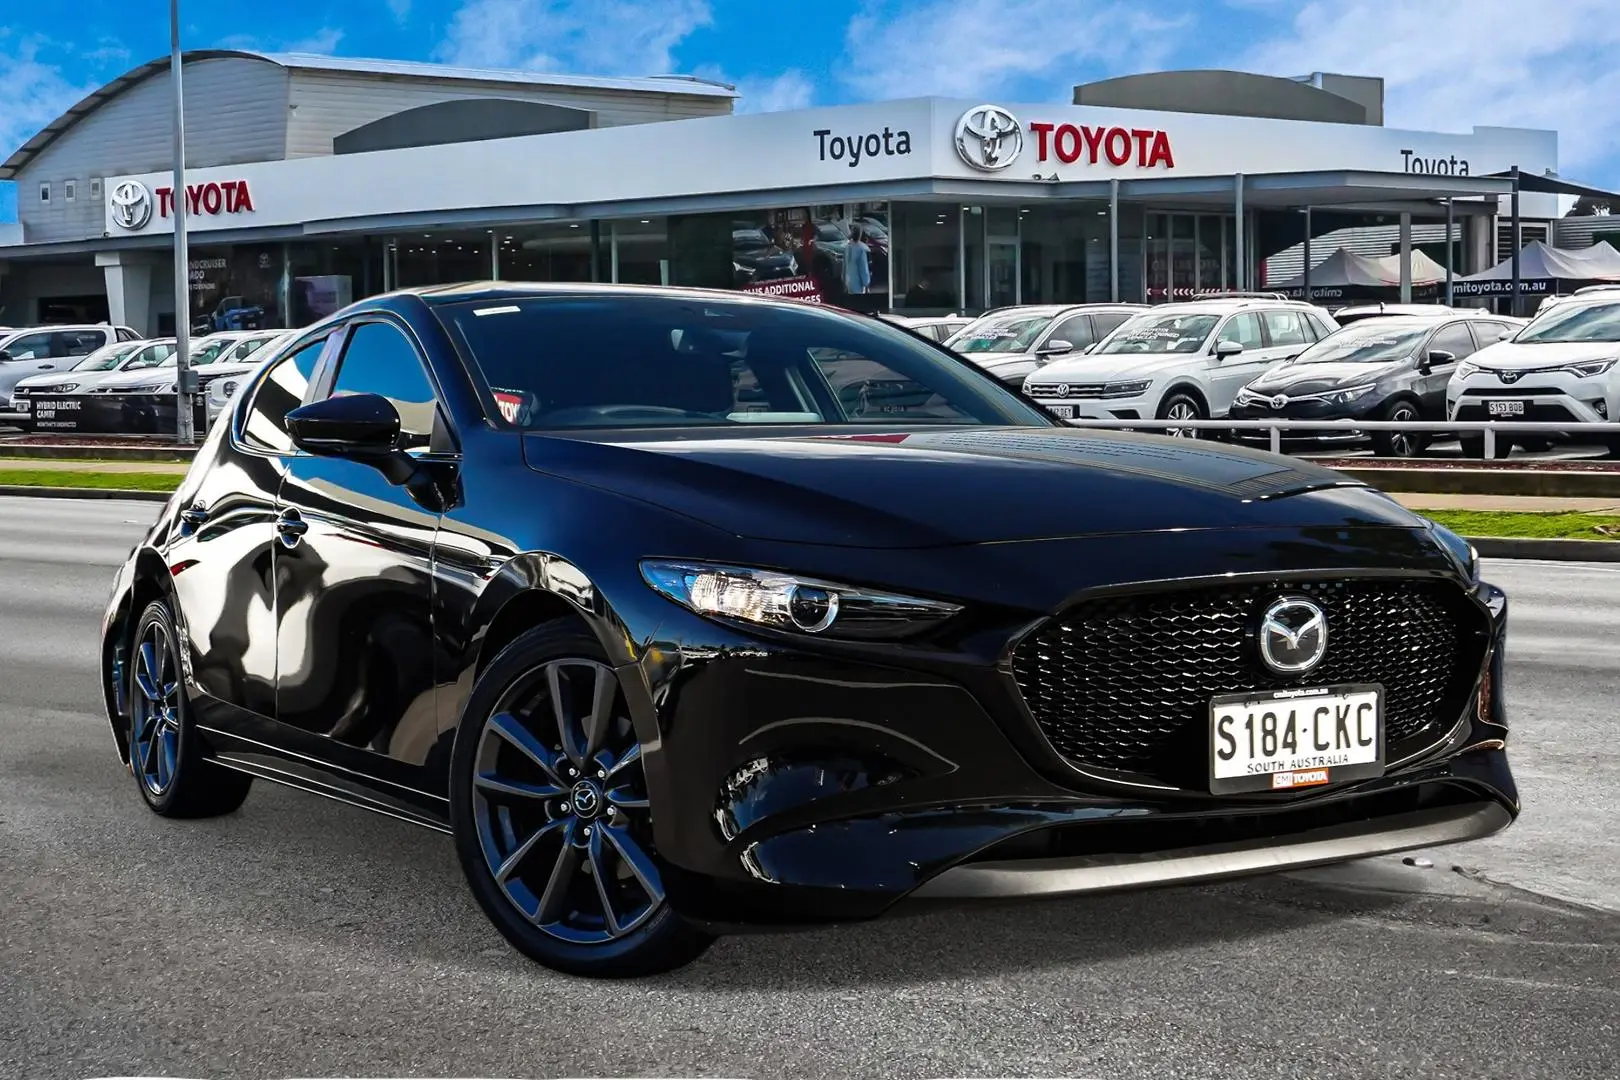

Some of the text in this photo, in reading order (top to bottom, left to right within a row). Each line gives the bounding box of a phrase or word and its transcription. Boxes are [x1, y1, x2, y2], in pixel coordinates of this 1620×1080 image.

[813, 127, 912, 168] Toyota
[1030, 122, 1175, 168] TOYOTA
[1400, 149, 1469, 176] Toyota
[764, 280, 815, 296] ADDITIONAL
[1453, 281, 1547, 295] mitoyota.cm.au
[1247, 753, 1349, 775] SOUTH AUSTRALIA
